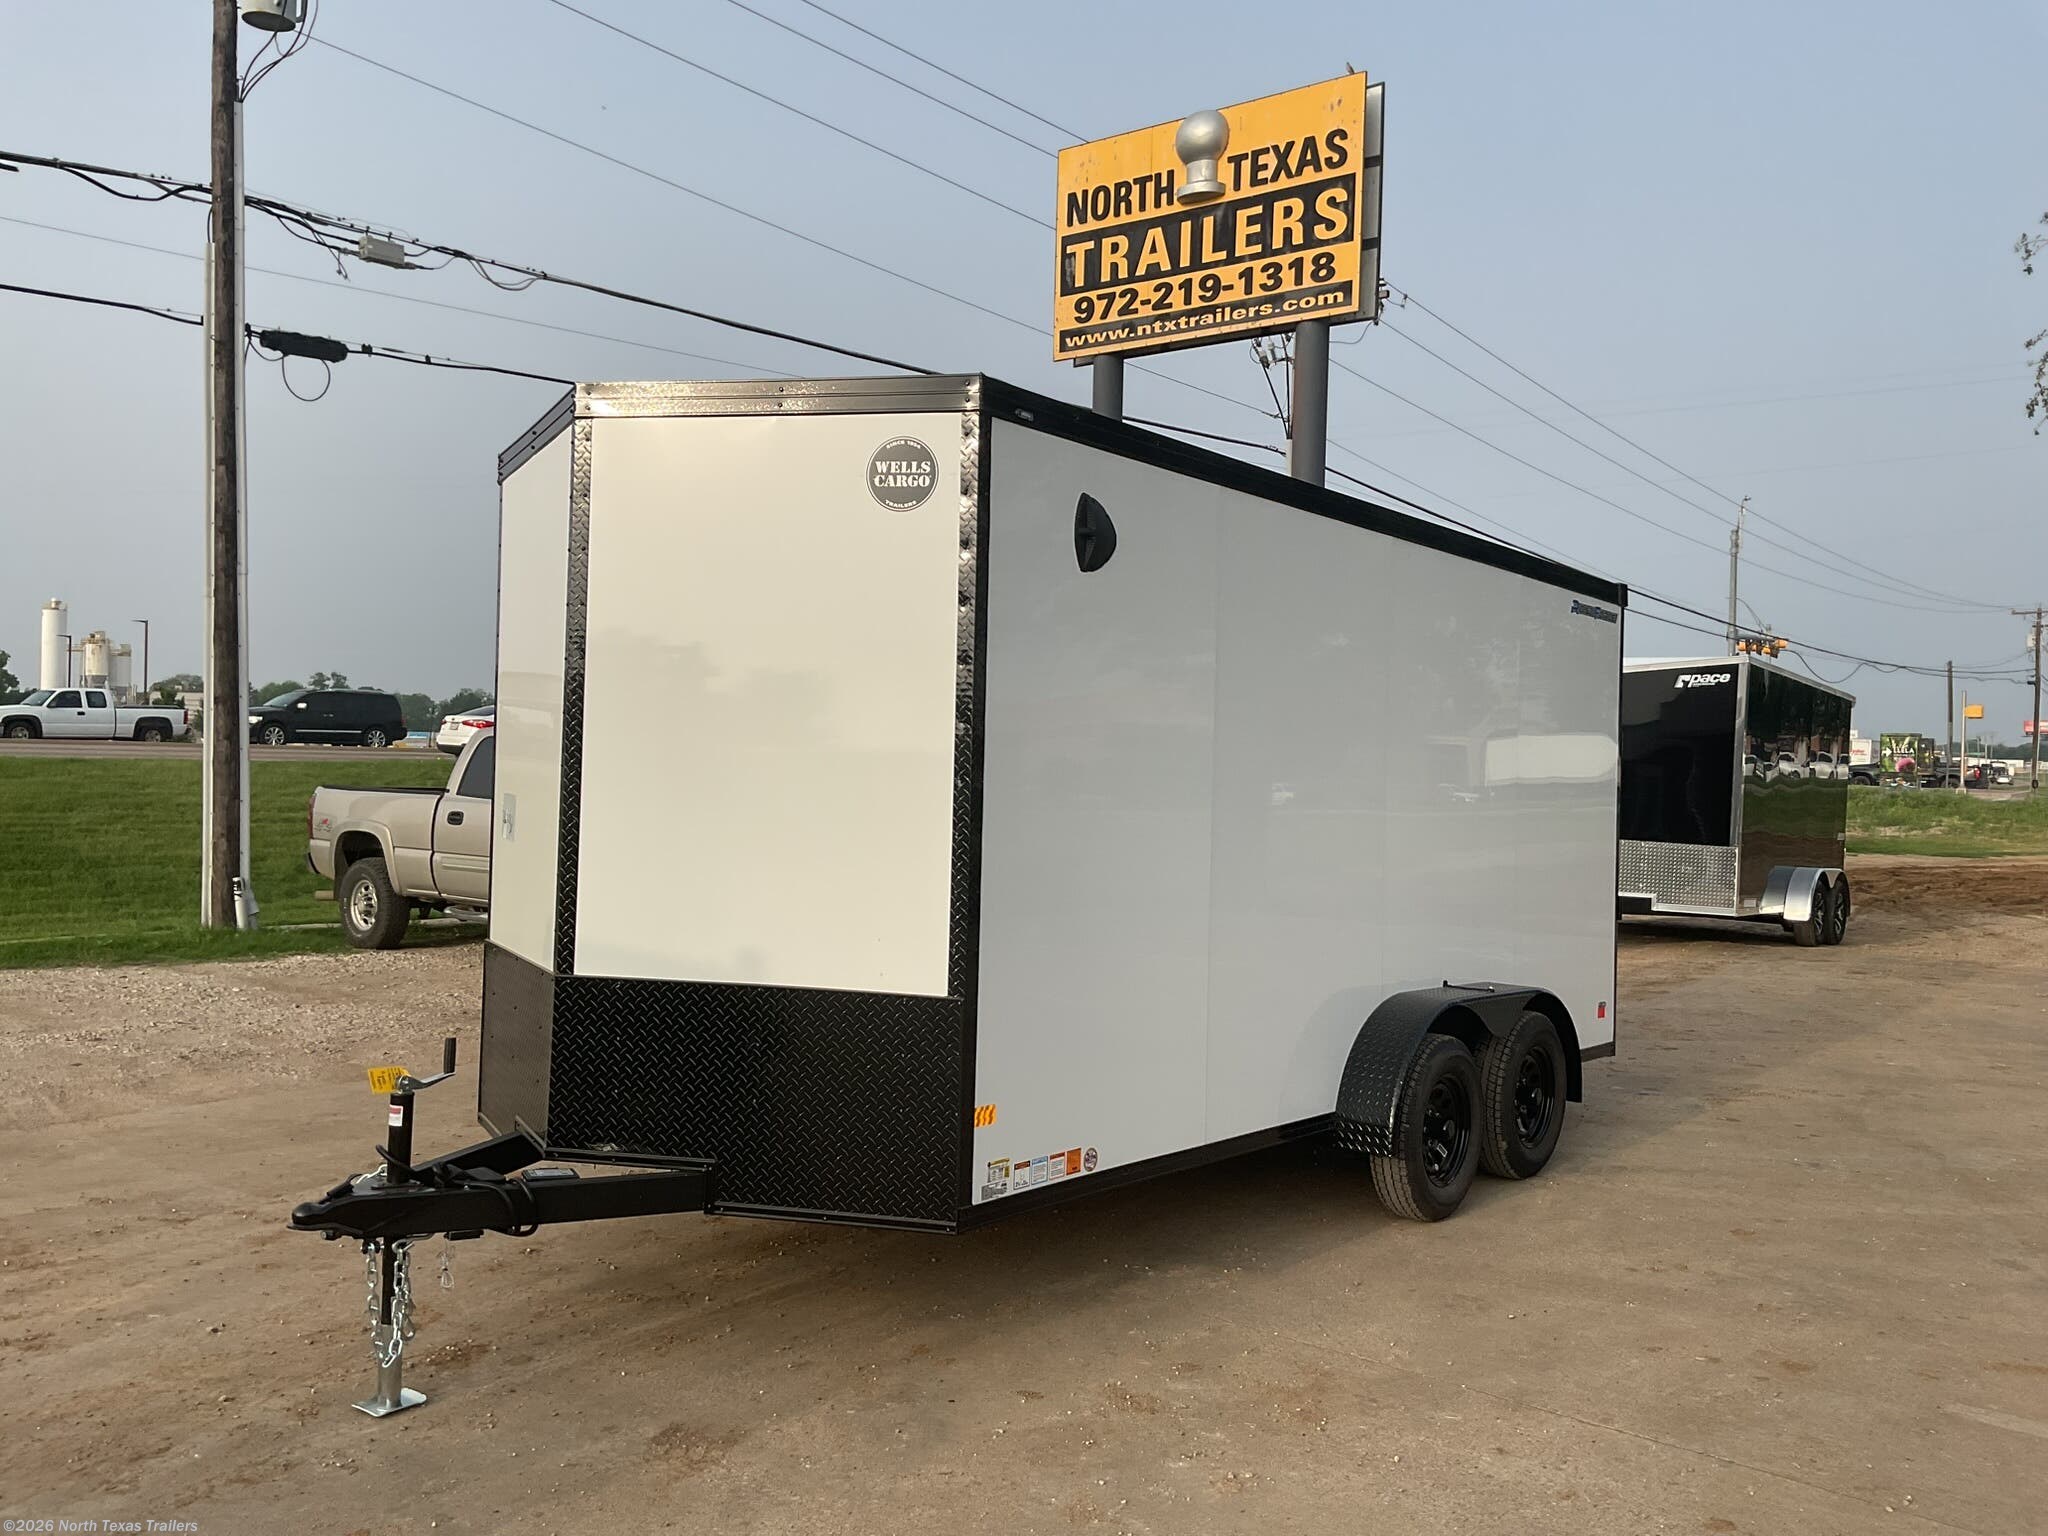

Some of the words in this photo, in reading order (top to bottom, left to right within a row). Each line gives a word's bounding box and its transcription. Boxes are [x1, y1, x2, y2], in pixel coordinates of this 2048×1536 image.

[1066, 169, 1175, 228] NORTH
[1227, 128, 1349, 192] TEXAS
[1066, 187, 1349, 288] TRAILERS
[1064, 289, 1344, 348] www.ntxtrailers.com
[1073, 251, 1336, 324] 972-219-1318
[874, 474, 931, 487] CARGO
[875, 461, 931, 474] WELLS
